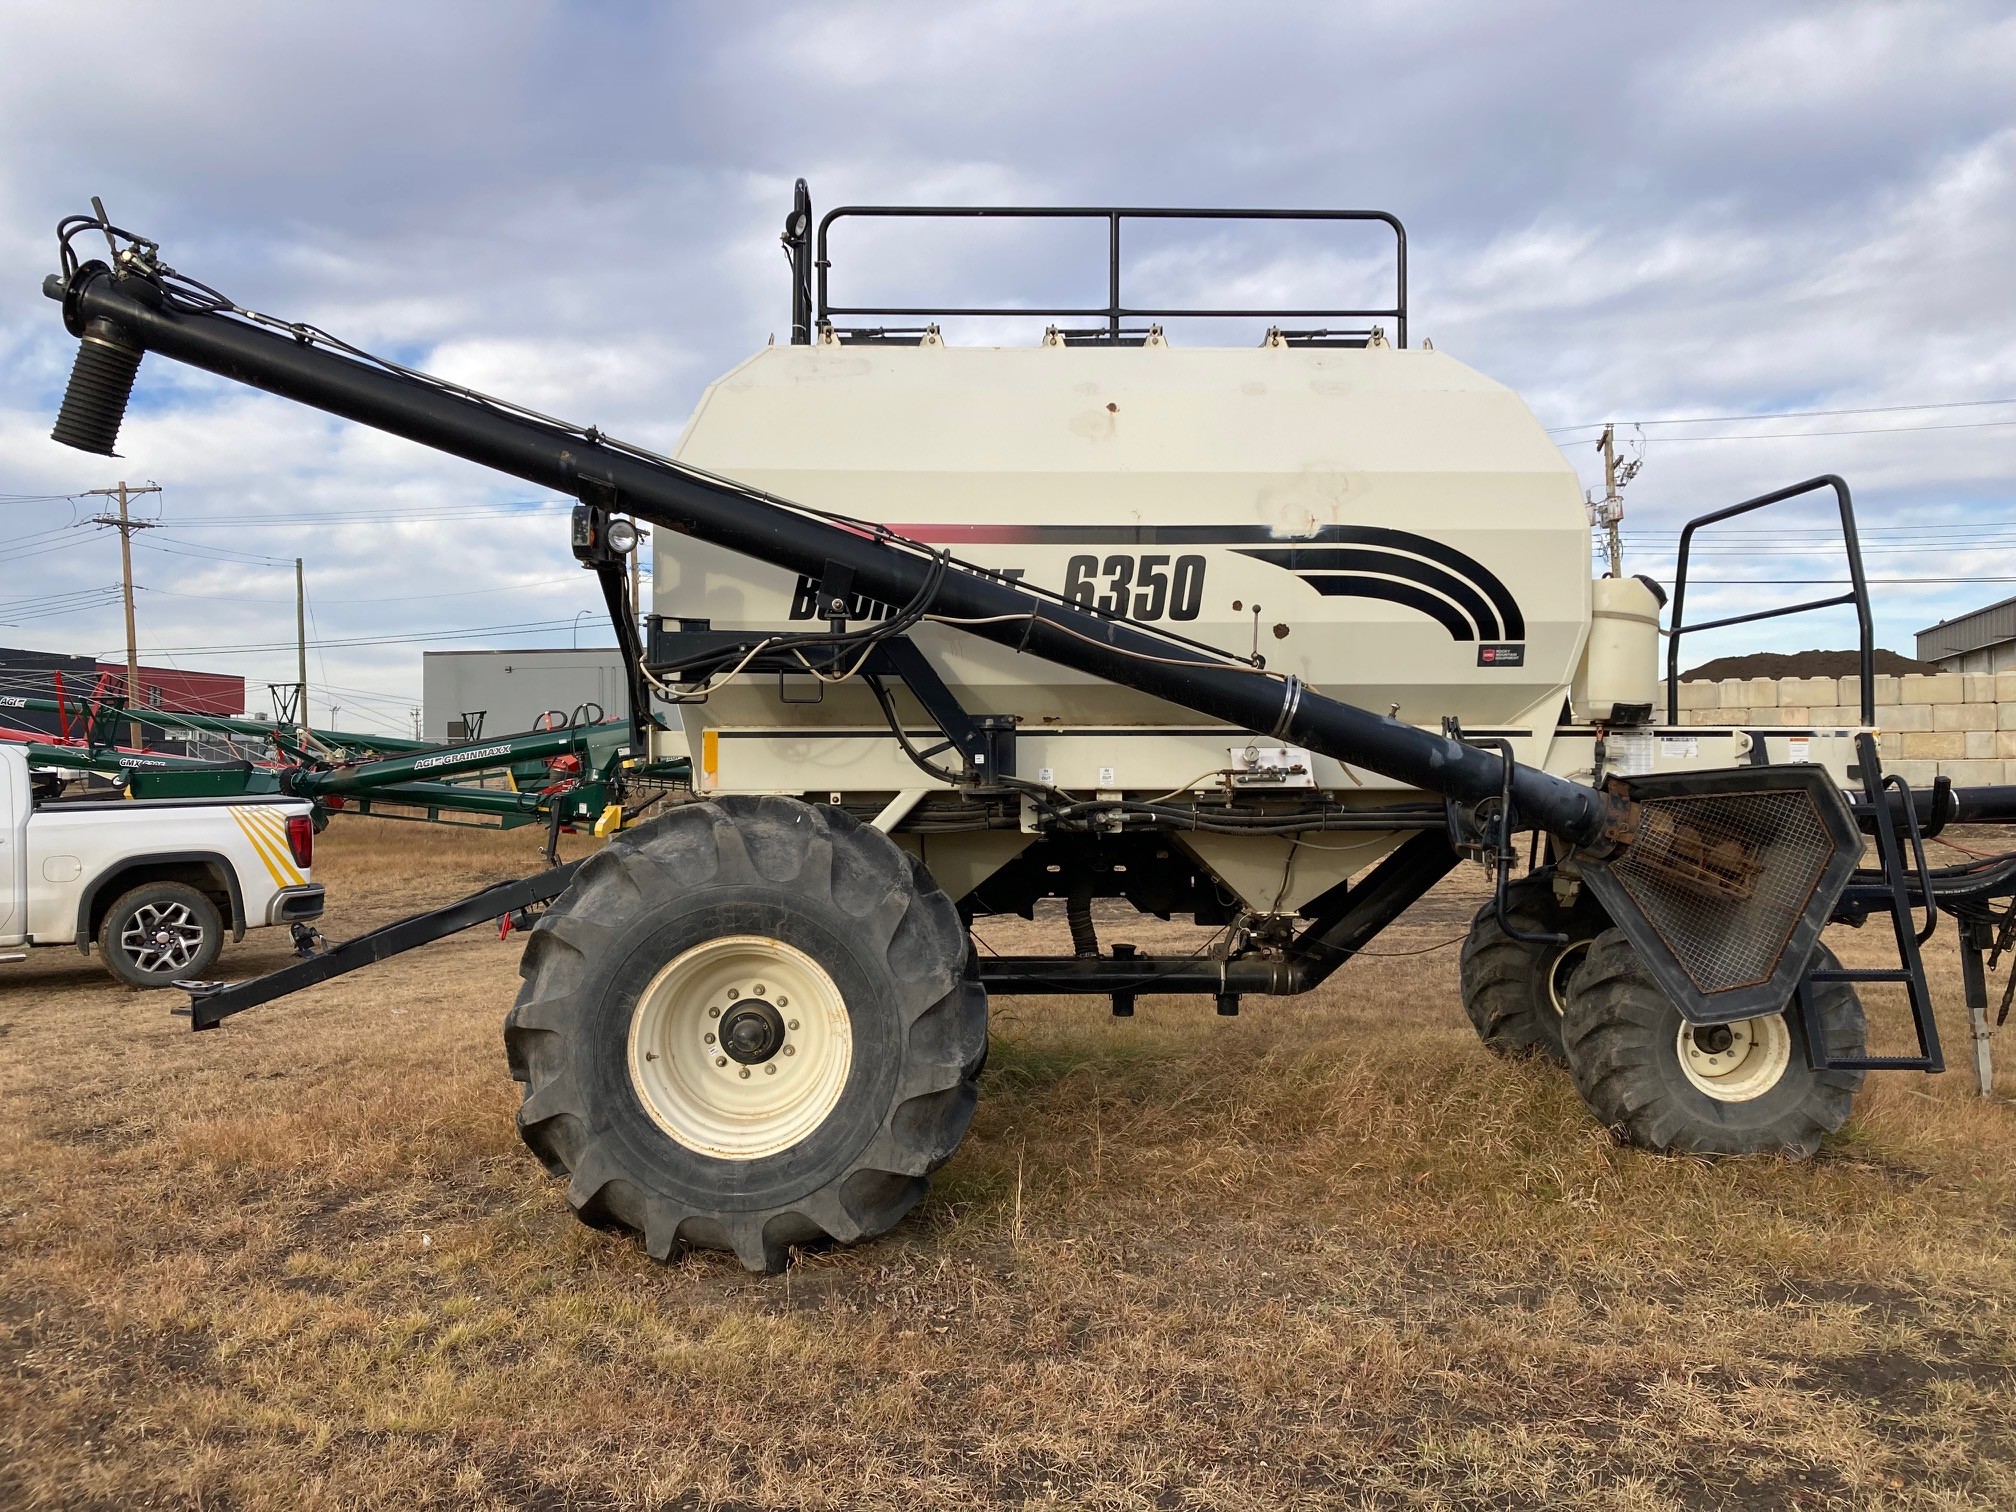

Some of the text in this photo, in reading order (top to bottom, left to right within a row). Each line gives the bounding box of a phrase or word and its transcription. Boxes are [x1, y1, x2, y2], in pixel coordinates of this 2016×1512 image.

[1062, 555, 1206, 621] 6350
[0, 697, 18, 706] AGI
[415, 745, 511, 769] AGI GRAINMAXX
